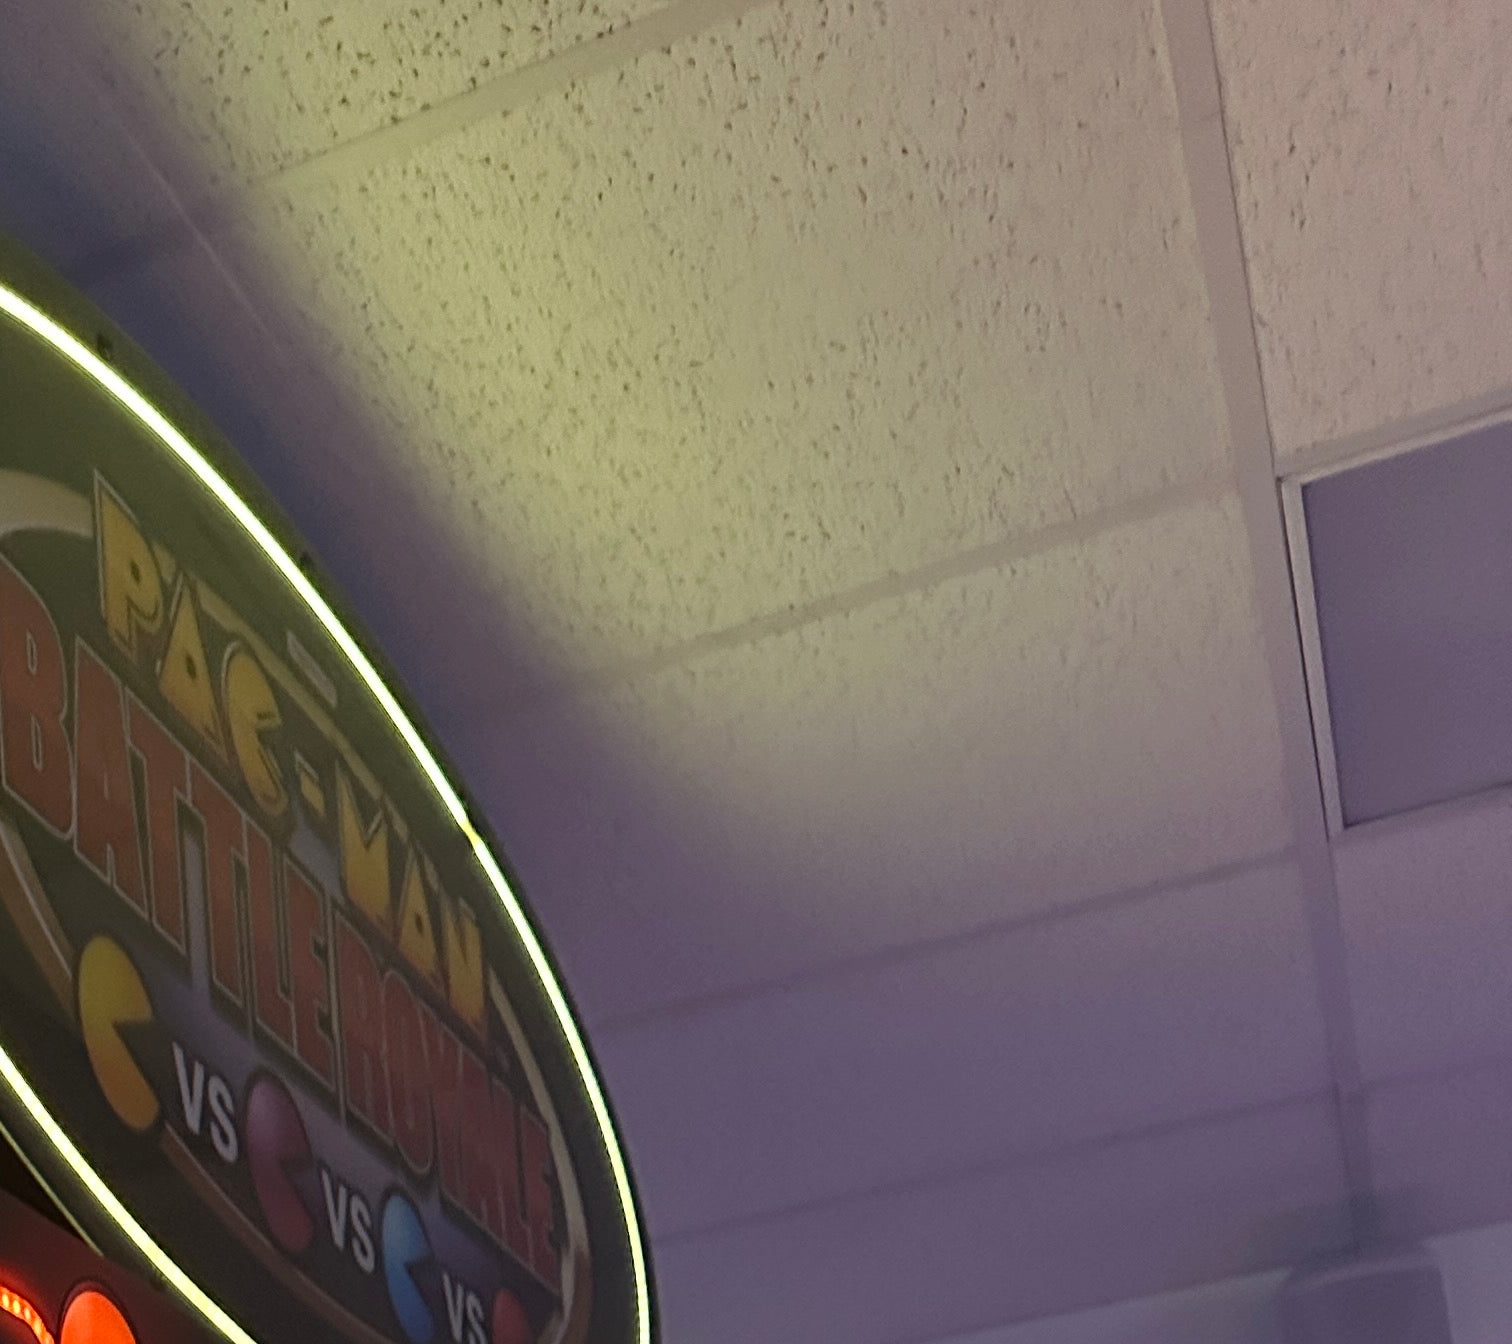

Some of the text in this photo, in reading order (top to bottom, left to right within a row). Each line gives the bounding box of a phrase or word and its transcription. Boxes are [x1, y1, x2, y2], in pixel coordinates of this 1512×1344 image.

[94, 470, 486, 1032] PAC-MAN
[170, 1048, 240, 1165] VS
[320, 1168, 376, 1275] VS
[328, 908, 563, 1310] ROYALE
